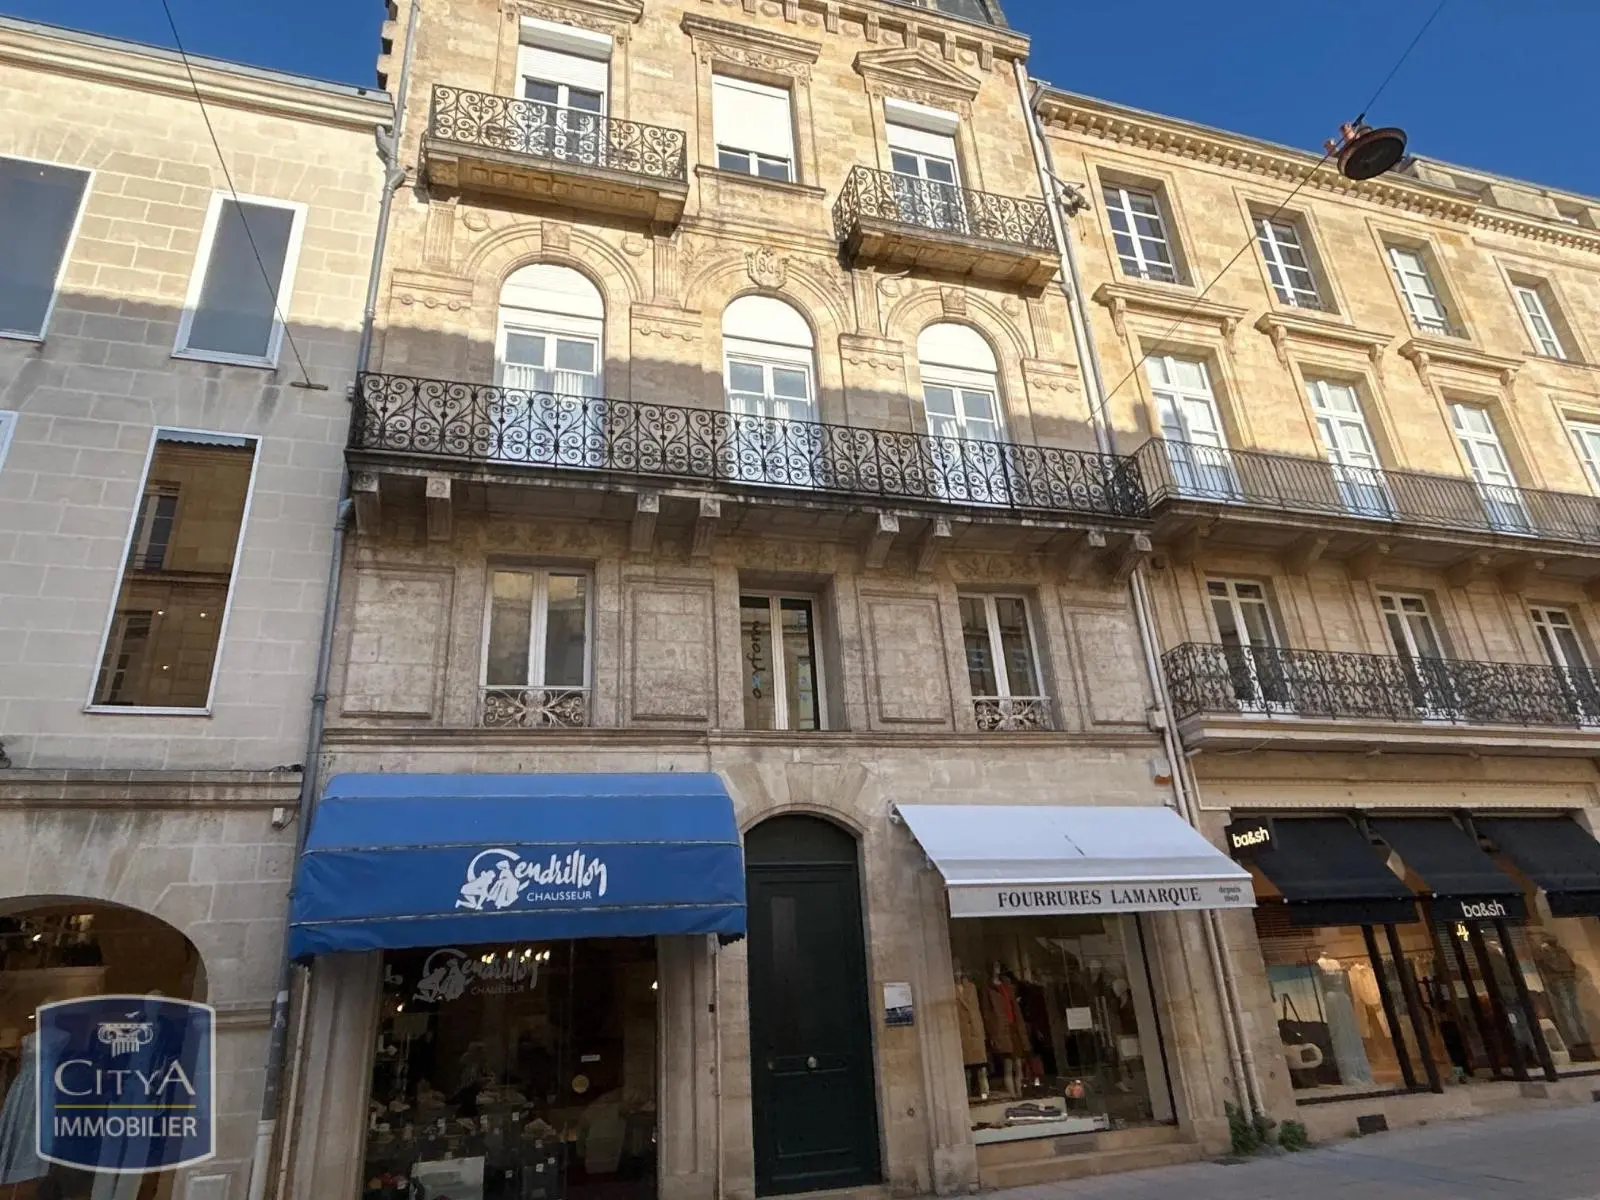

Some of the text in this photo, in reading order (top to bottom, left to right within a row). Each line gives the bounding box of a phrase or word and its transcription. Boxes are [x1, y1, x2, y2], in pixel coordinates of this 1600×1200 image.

[1232, 826, 1270, 848] ba&sh
[526, 890, 592, 902] CHAUSSEUR
[998, 887, 1201, 908] FOURRURES LAMARQUE
[1461, 899, 1506, 917] ba&sh
